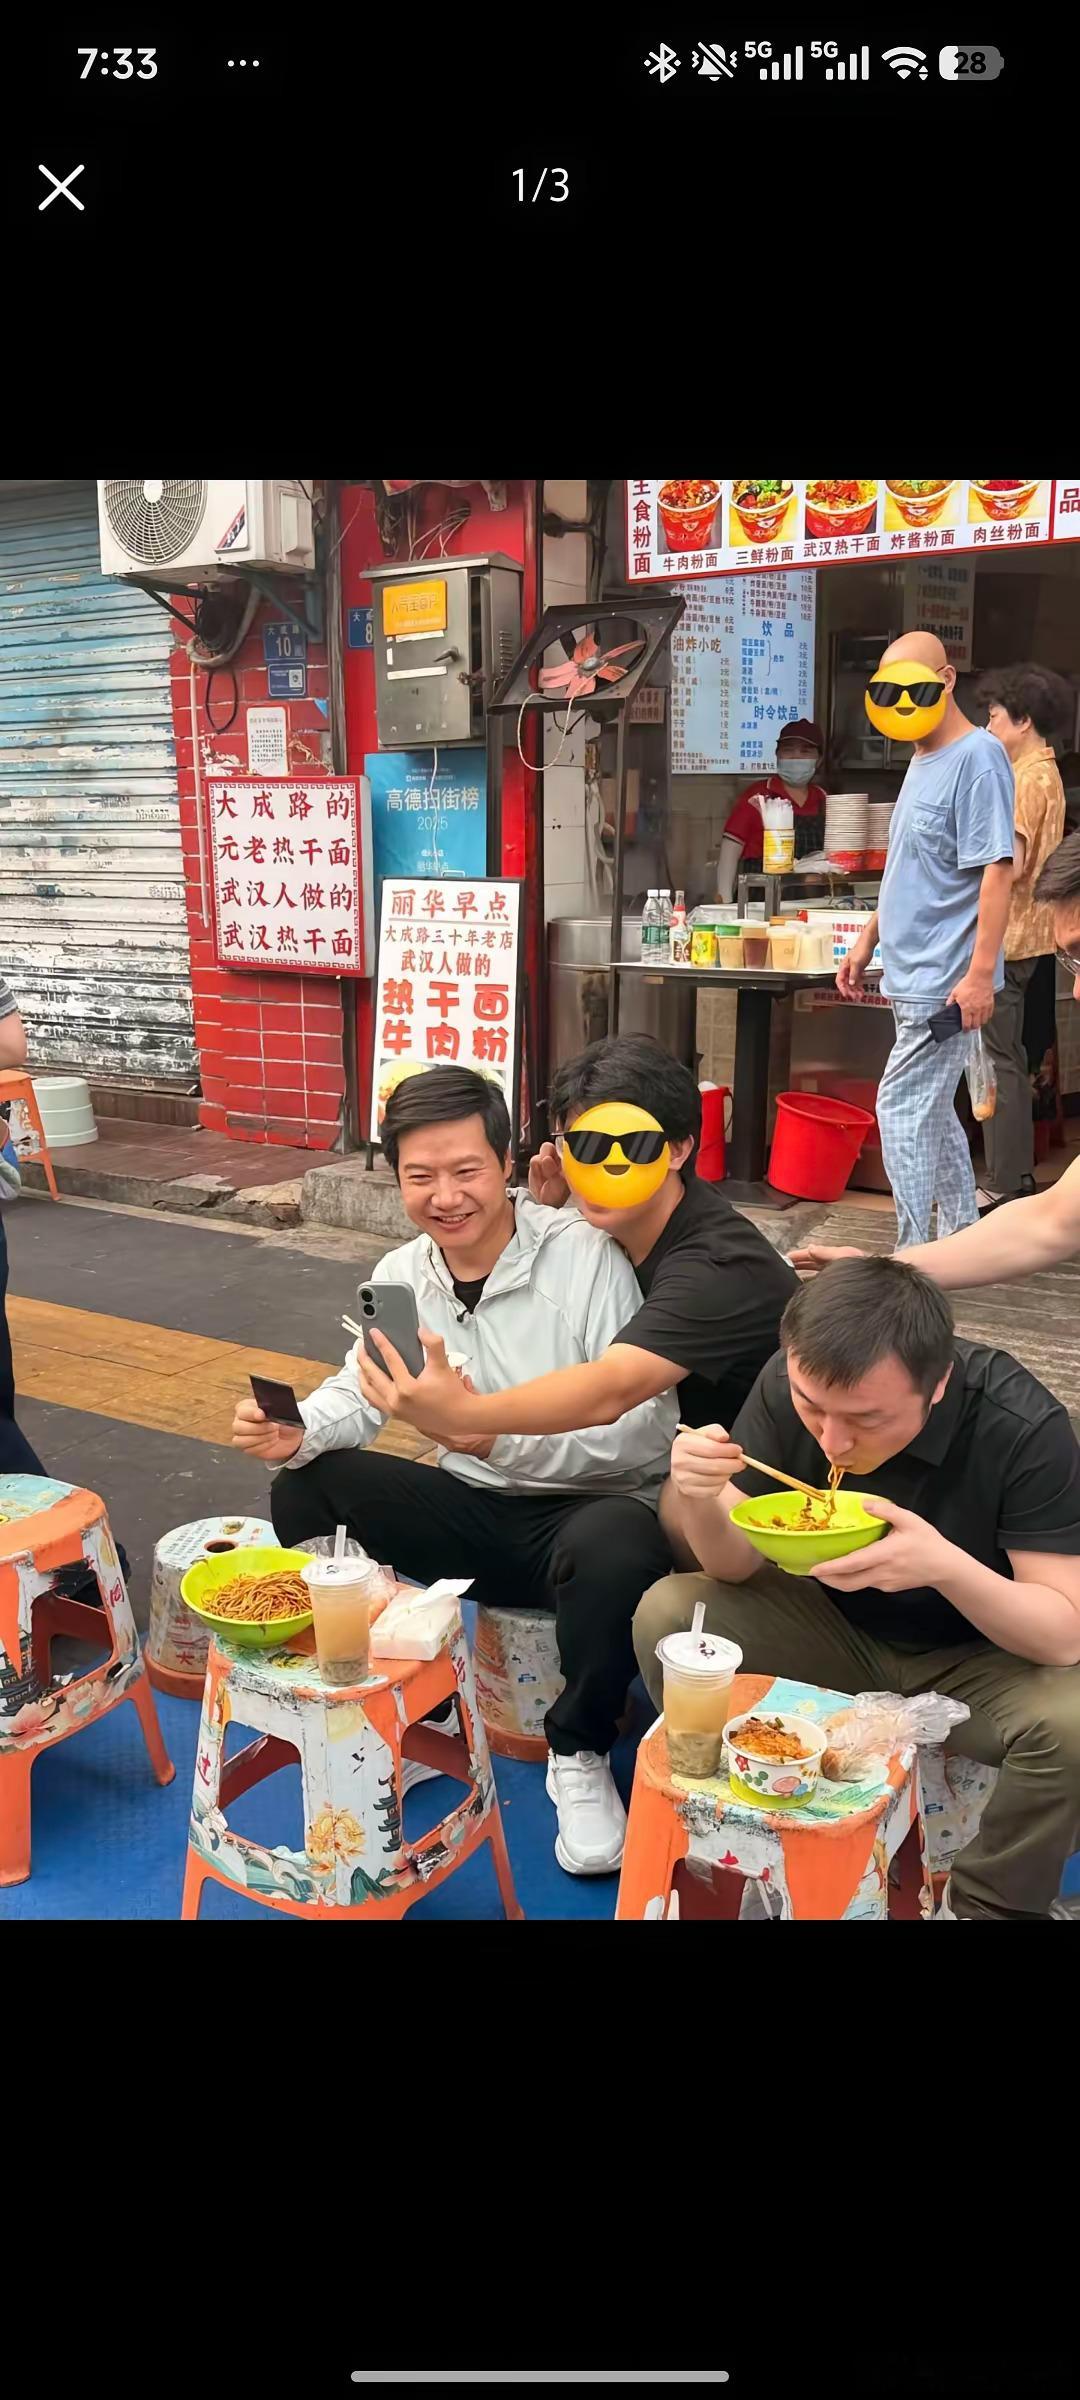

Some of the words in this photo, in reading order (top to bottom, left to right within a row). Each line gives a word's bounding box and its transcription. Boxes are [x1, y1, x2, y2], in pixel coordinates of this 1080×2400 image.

[1059, 487, 1080, 514] 品
[890, 529, 956, 550] 炸酱粉面
[973, 521, 1041, 544] 肉丝粉面
[735, 545, 794, 566] 三鲜粉面
[803, 535, 881, 557] 武汉热干面
[663, 551, 719, 572] 牛肉粉面
[762, 620, 794, 638] 饮品
[276, 636, 292, 657] 10
[673, 636, 722, 654] 油炸小吃
[754, 705, 799, 721] 时令饮品
[216, 790, 350, 820] 大成路的
[385, 786, 480, 812] 高德扫街榜
[218, 835, 350, 866] 元老热干面
[220, 878, 352, 912] 武汉人做的
[391, 889, 509, 921] 丽华早点
[223, 920, 352, 956] 武汉热干面
[384, 925, 514, 950] 大成路三十年老店
[400, 950, 491, 977] 武汉人做的
[382, 978, 509, 1021] 热干面
[382, 1019, 509, 1062] 牛肉粉
